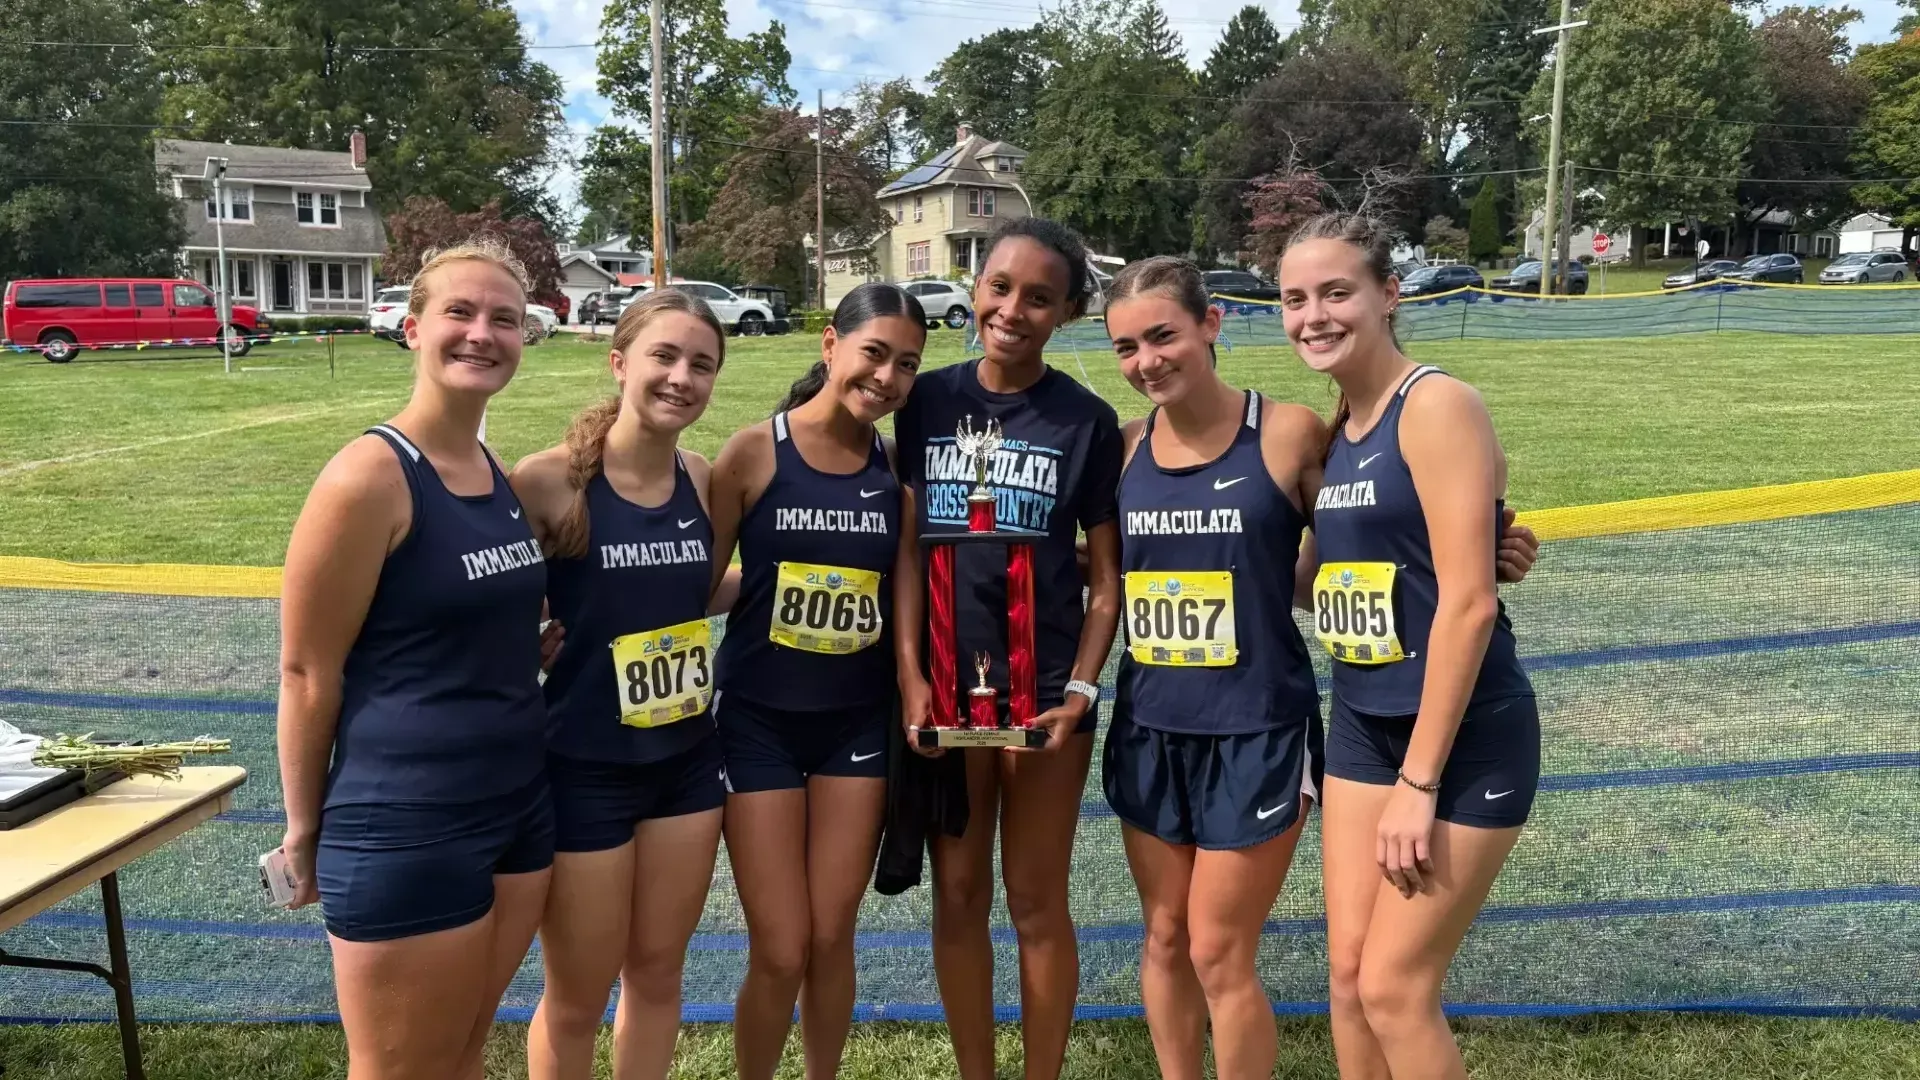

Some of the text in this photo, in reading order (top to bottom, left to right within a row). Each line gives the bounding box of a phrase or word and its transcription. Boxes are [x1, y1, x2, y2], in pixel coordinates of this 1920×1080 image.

[1593, 239, 1608, 248] STOP
[1000, 438, 1029, 451] MACS
[926, 483, 1056, 530] CROSS UNTRY
[775, 508, 888, 534] IMMACULATA
[1127, 508, 1243, 535] IMMACULATA
[600, 539, 708, 569] IMMACULATA
[805, 572, 826, 585] 2L
[1148, 581, 1165, 592] 2L
[779, 586, 877, 634] 8069
[1133, 597, 1226, 641] 8067
[1317, 589, 1388, 638] 8065
[642, 639, 660, 653] 2L
[625, 645, 709, 706] 8073
